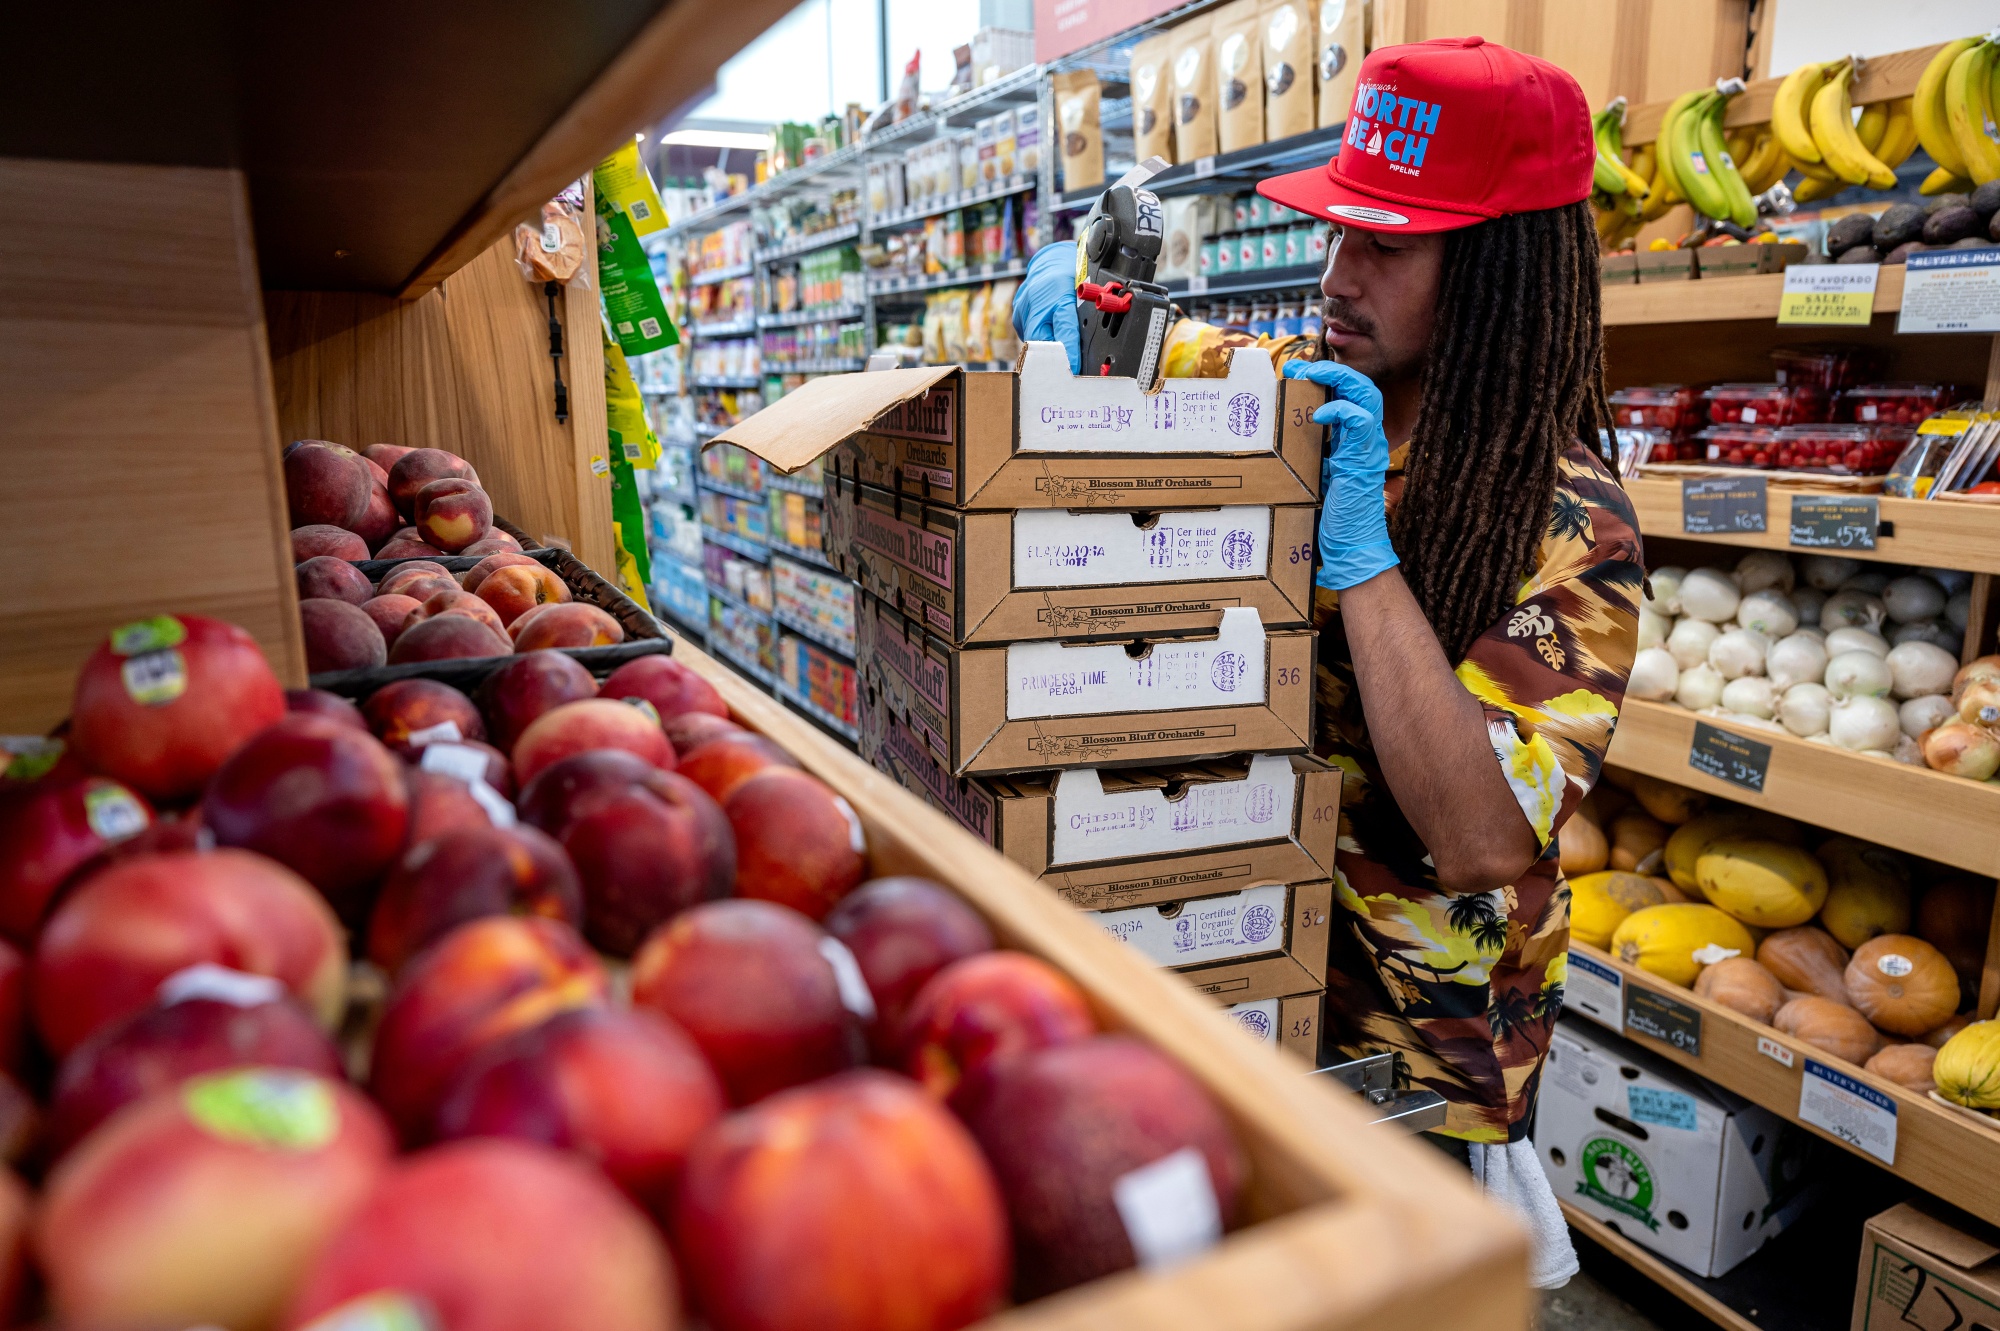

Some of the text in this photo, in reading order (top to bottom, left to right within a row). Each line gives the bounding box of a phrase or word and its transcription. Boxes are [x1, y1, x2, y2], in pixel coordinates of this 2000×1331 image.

[1355, 83, 1442, 135] NORTH
[1347, 116, 1429, 168] BECH
[1390, 163, 1420, 177] PIPELINE
[1914, 254, 1968, 266] BUYER'S
[1820, 276, 1872, 284] AVOCADO
[1806, 294, 1846, 303] SALE!
[1180, 390, 1220, 400] Certified
[906, 394, 950, 436] Bluff
[1183, 403, 1218, 414] Orgaic
[1292, 406, 1313, 428] 36
[1057, 423, 1079, 432] ylow
[906, 441, 947, 466] Orchards
[1089, 478, 1212, 488] Blossom Bluff Orchards
[1727, 491, 1758, 499] TOMATO
[1177, 527, 1216, 537] Cerified
[856, 509, 949, 581] Blossom Bluff
[1178, 538, 1214, 549] Oranic
[1289, 543, 1312, 564] 36
[908, 573, 946, 610] Orchards
[1090, 602, 1211, 617] Blossom Bluff Orchards
[928, 608, 950, 631] California
[878, 623, 945, 706] Blossom Bluff
[1021, 670, 1108, 691] PRINCESS TIME
[1277, 667, 1300, 686] 36
[1049, 686, 1083, 697] PEACH
[914, 692, 943, 735] Orchards
[1081, 729, 1205, 745] Blossom Bluff Orchards
[888, 723, 990, 839] Blossom Bluff
[1202, 784, 1240, 797] Cerified
[1128, 805, 1157, 825] Bby
[1313, 805, 1334, 824] 40
[1108, 870, 1223, 892] Blossom Bluff Orchards
[1199, 906, 1236, 921] Certified
[1247, 907, 1275, 924] REAL
[1103, 920, 1143, 936] OROSA
[1201, 918, 1234, 930] Organic
[1200, 928, 1235, 942] by CCOF
[1291, 1017, 1311, 1038] 32
[1762, 1041, 1790, 1060] NEW
[1812, 1066, 1889, 1108] BUYER'S PICKS
